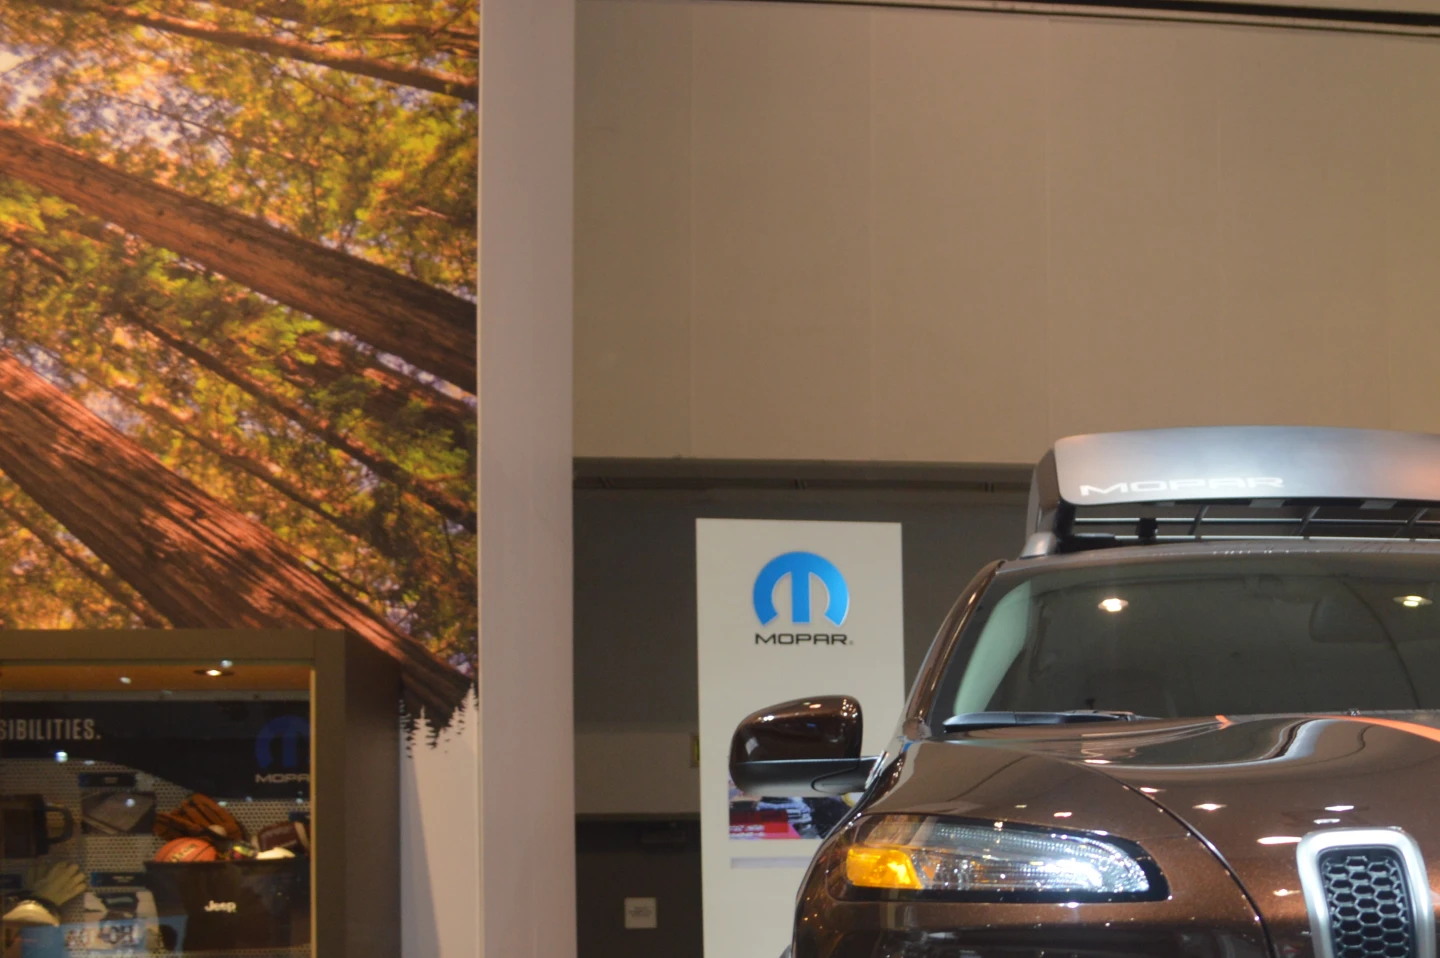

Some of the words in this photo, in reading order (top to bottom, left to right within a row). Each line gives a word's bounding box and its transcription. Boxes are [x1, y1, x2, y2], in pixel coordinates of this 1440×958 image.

[1079, 476, 1286, 497] MOPAR
[755, 633, 848, 645] MOPAR
[204, 900, 237, 913] Jeep
